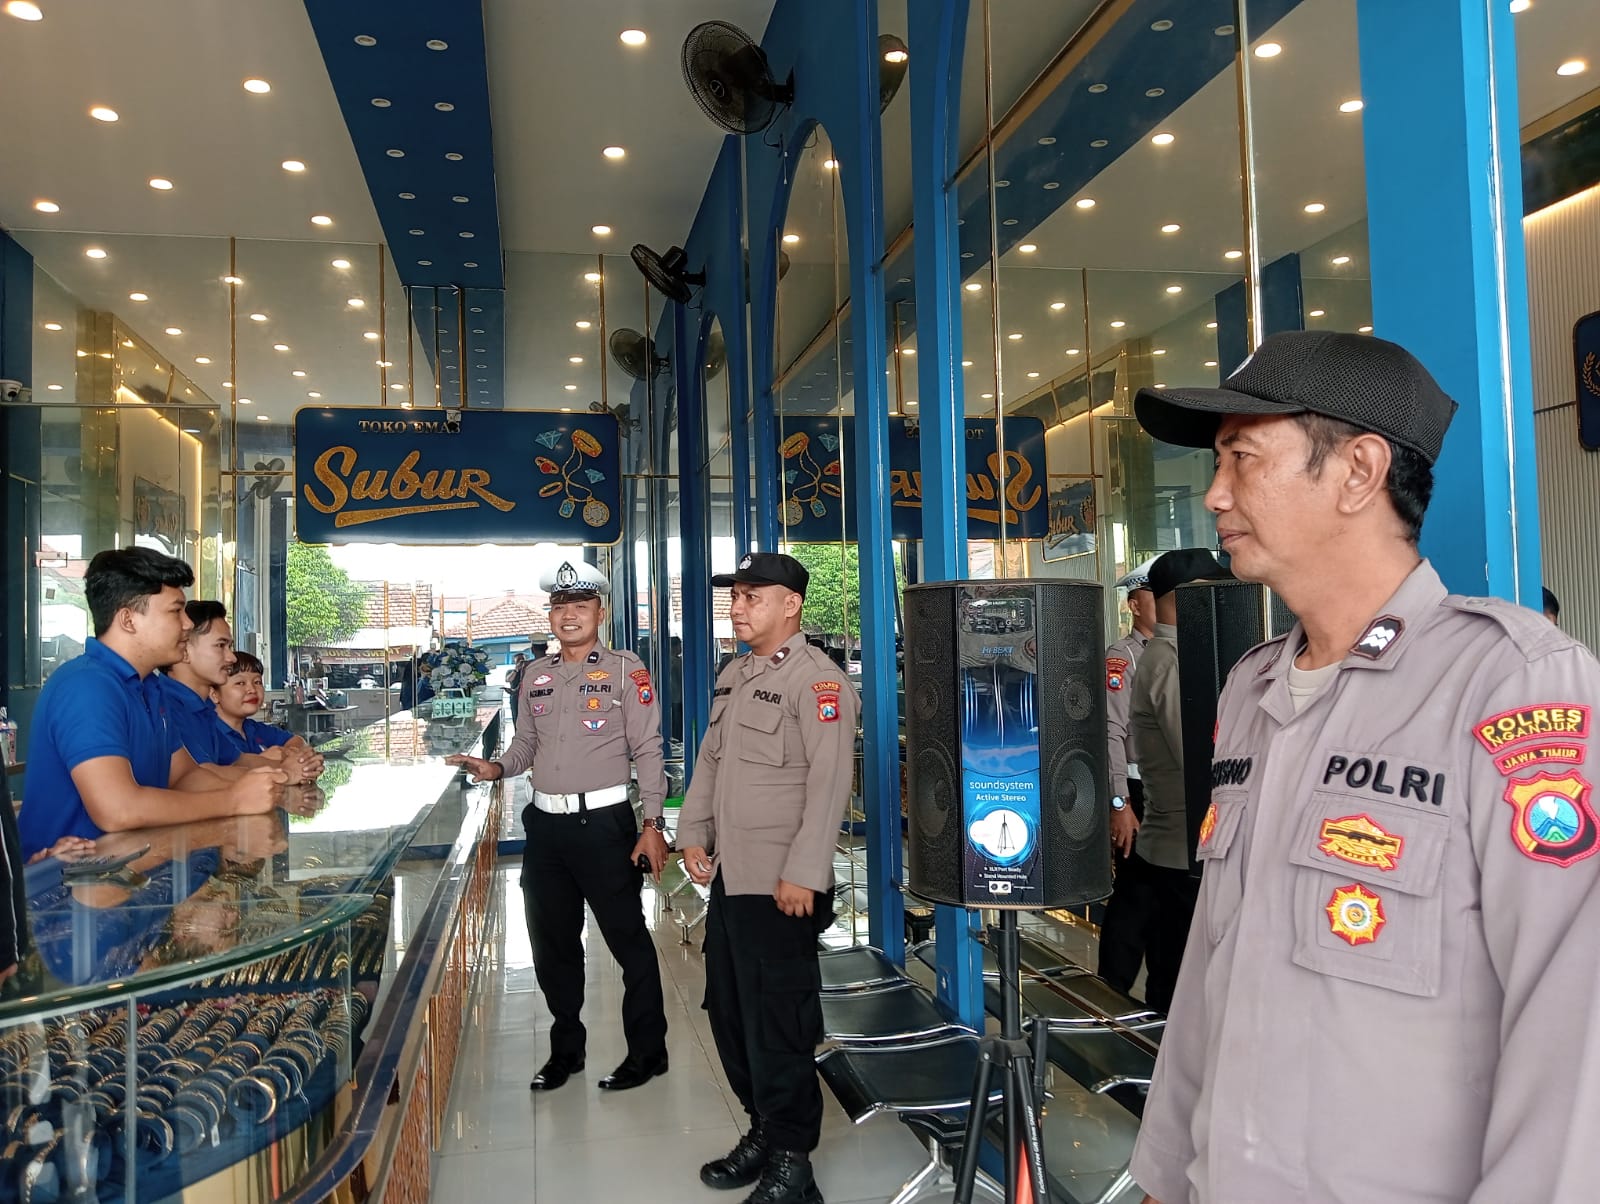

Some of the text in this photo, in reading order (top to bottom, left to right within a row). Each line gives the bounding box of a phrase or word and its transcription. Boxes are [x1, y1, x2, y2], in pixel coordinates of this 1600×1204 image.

[359, 421, 407, 433] TOKO
[579, 685, 612, 693] POLRI
[752, 689, 783, 705] POLRI
[1481, 709, 1582, 741] POLRES
[1493, 722, 1577, 747] NGANJUK
[1505, 748, 1578, 769] JAWA TIMUR
[1323, 755, 1445, 806] POLRI
[976, 793, 1026, 802] Active Stereo
